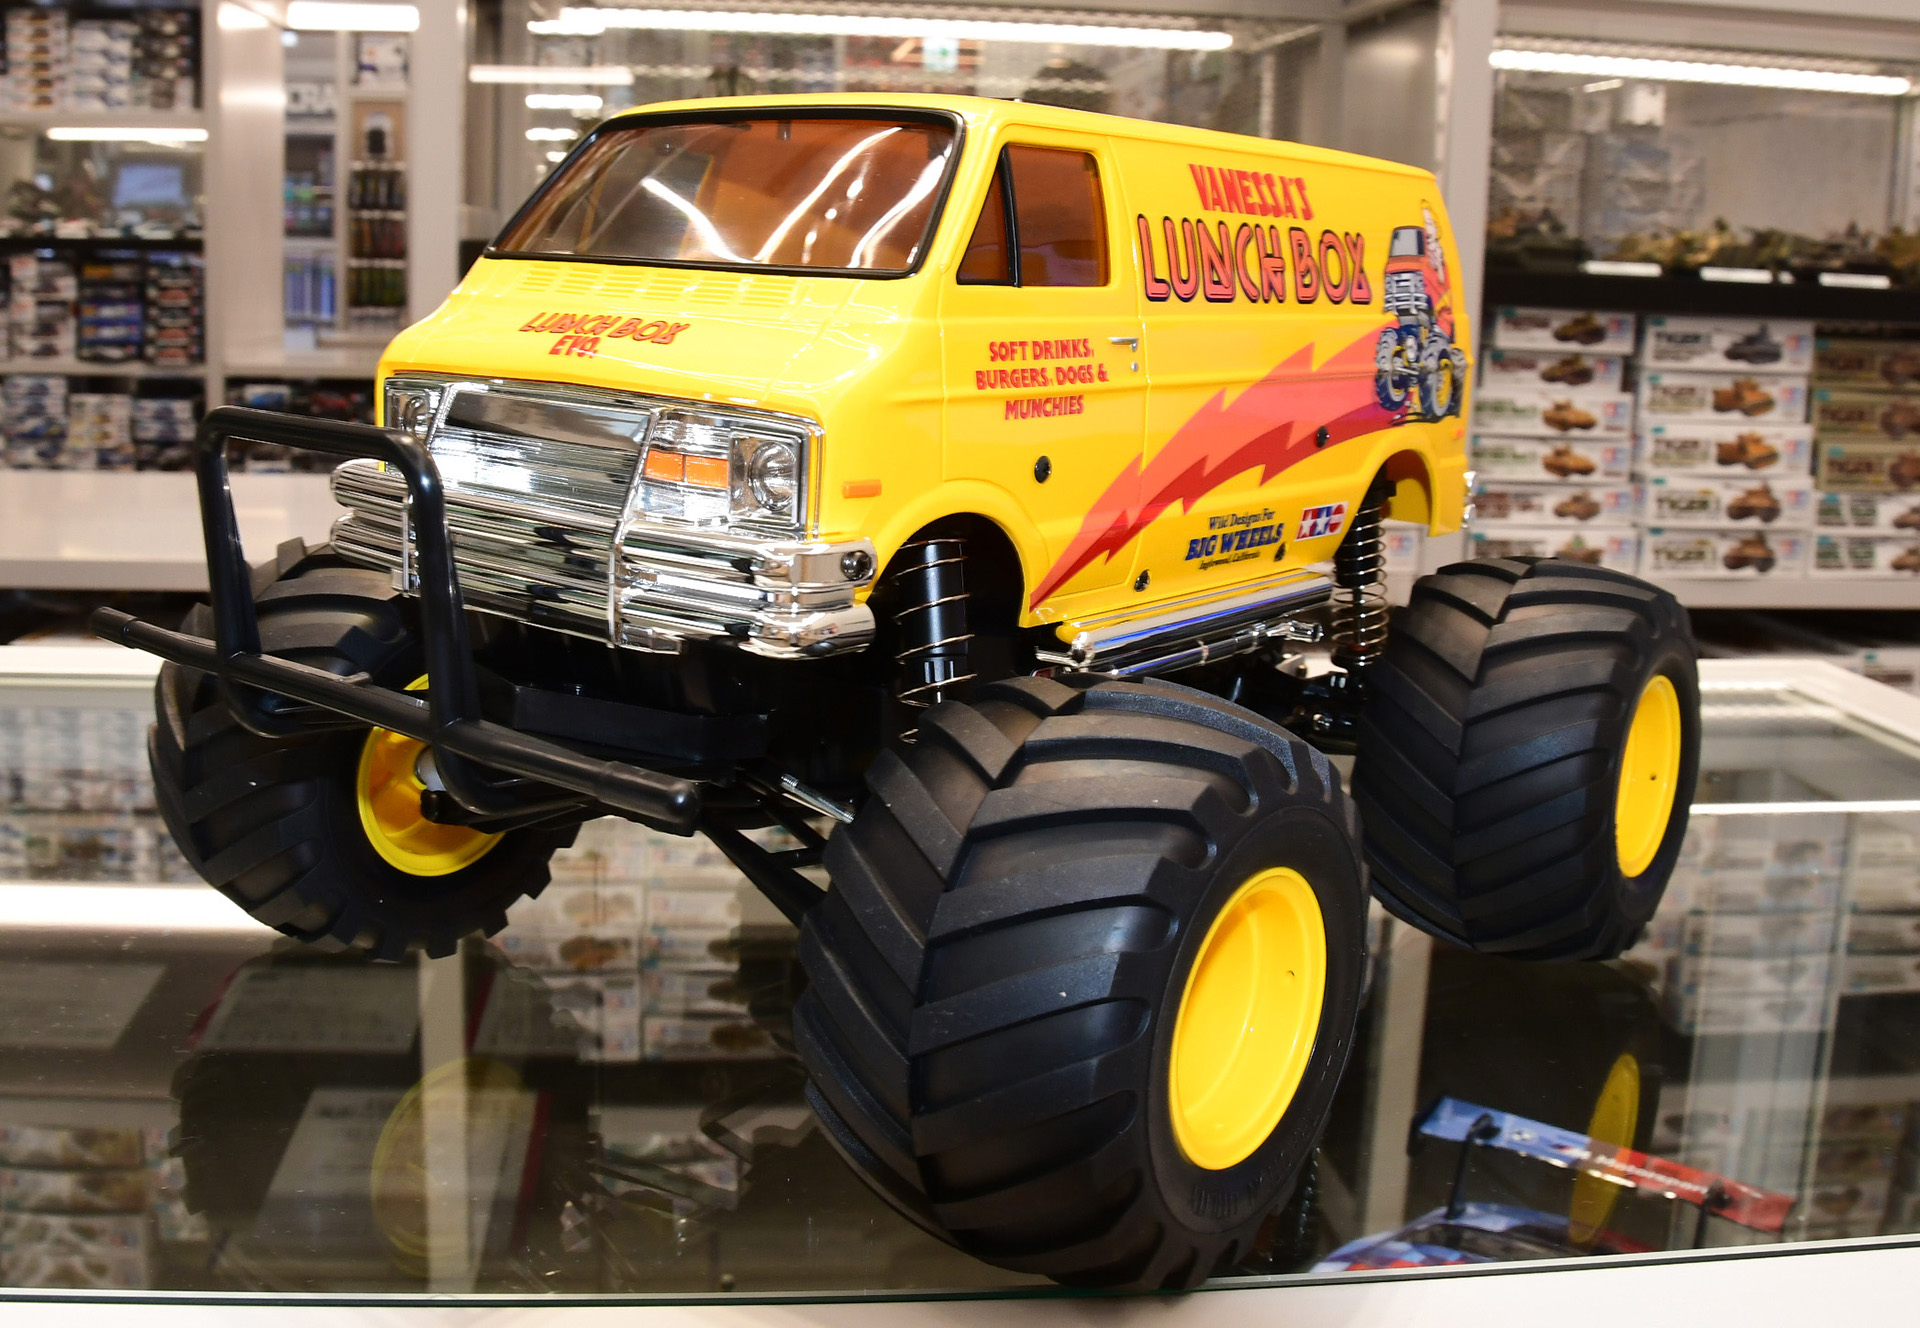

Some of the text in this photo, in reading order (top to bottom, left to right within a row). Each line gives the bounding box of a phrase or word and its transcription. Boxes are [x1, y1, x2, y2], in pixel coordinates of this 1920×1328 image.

[1189, 164, 1314, 221] VANESSA'S
[1137, 214, 1373, 305] LUNCH BOX
[518, 311, 691, 345] LUNCH BOX
[989, 340, 1028, 362] SOFT
[1055, 364, 1095, 386] DOGS
[1097, 362, 1110, 382] &
[1004, 394, 1085, 420] MUNCHIES
[1209, 508, 1275, 530] Wild Designs For
[1184, 523, 1284, 561] BIG WHEELS
